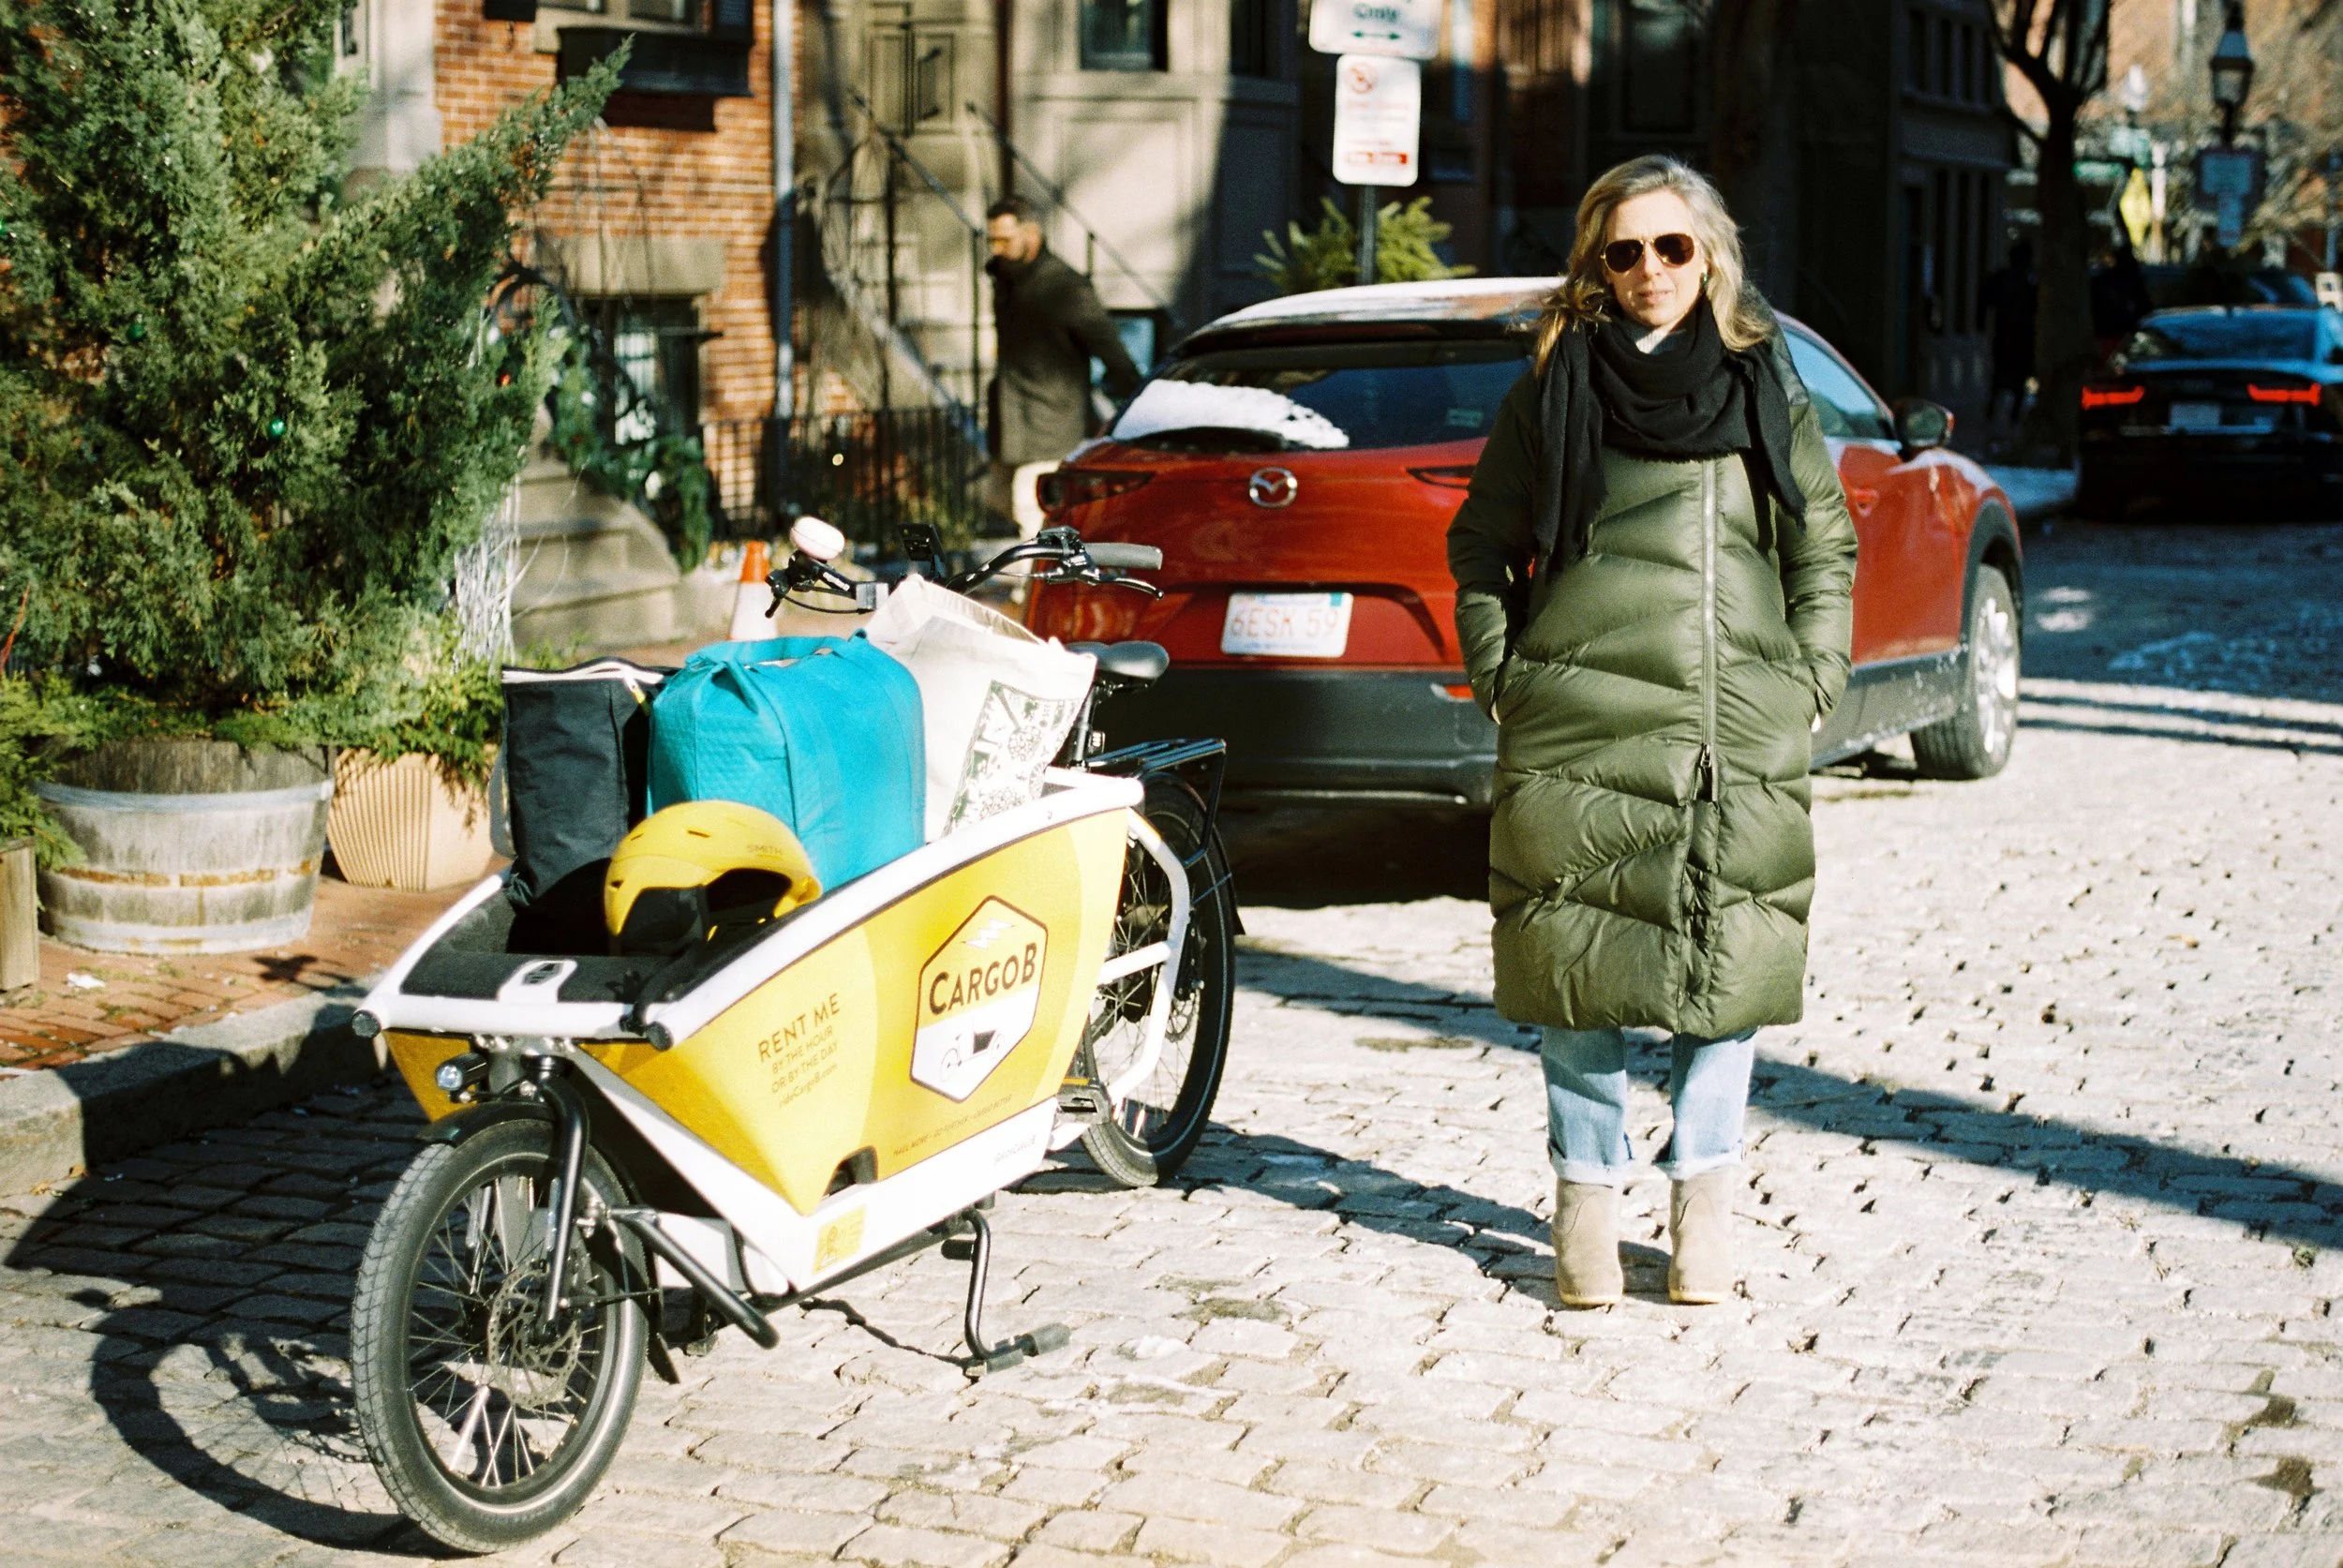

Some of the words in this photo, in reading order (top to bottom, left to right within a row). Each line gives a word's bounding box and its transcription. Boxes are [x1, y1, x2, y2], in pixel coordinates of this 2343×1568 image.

[747, 844, 782, 854] SMITH
[757, 1013, 806, 1063] RENT
[813, 992, 841, 1027] ME
[771, 1059, 784, 1075] BY
[785, 1044, 804, 1066] THE
[806, 1024, 833, 1052] HOUR
[771, 1075, 786, 1093] OR
[788, 1067, 799, 1083] BY
[800, 1053, 819, 1073] THE
[820, 1038, 838, 1060] DAY
